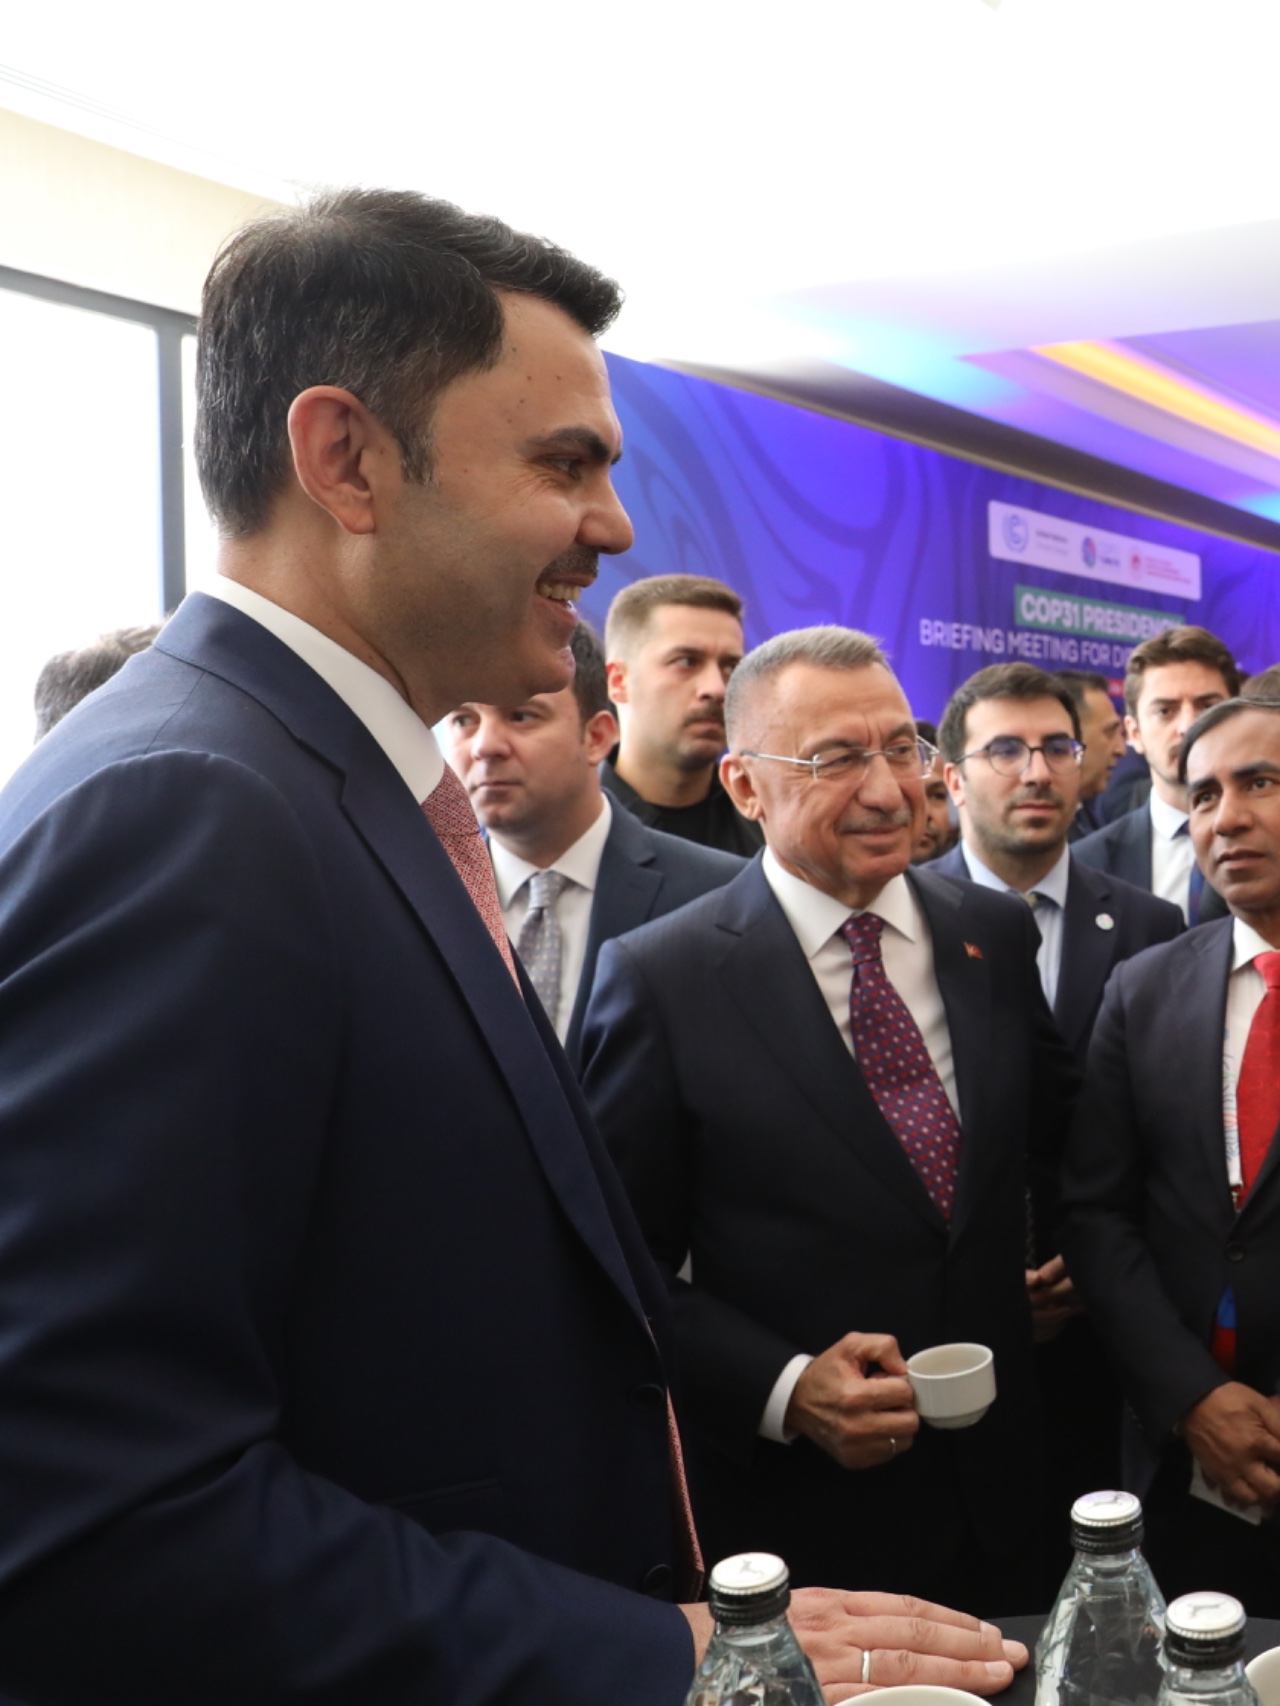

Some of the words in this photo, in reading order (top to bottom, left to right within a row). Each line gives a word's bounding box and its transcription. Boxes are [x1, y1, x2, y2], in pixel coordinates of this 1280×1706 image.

[1020, 592, 1080, 628] COP31
[1082, 604, 1181, 639] PRESIDEN
[919, 618, 1004, 654] BRIEFING
[1007, 631, 1078, 663] MEETING
[1080, 641, 1111, 666] FOR
